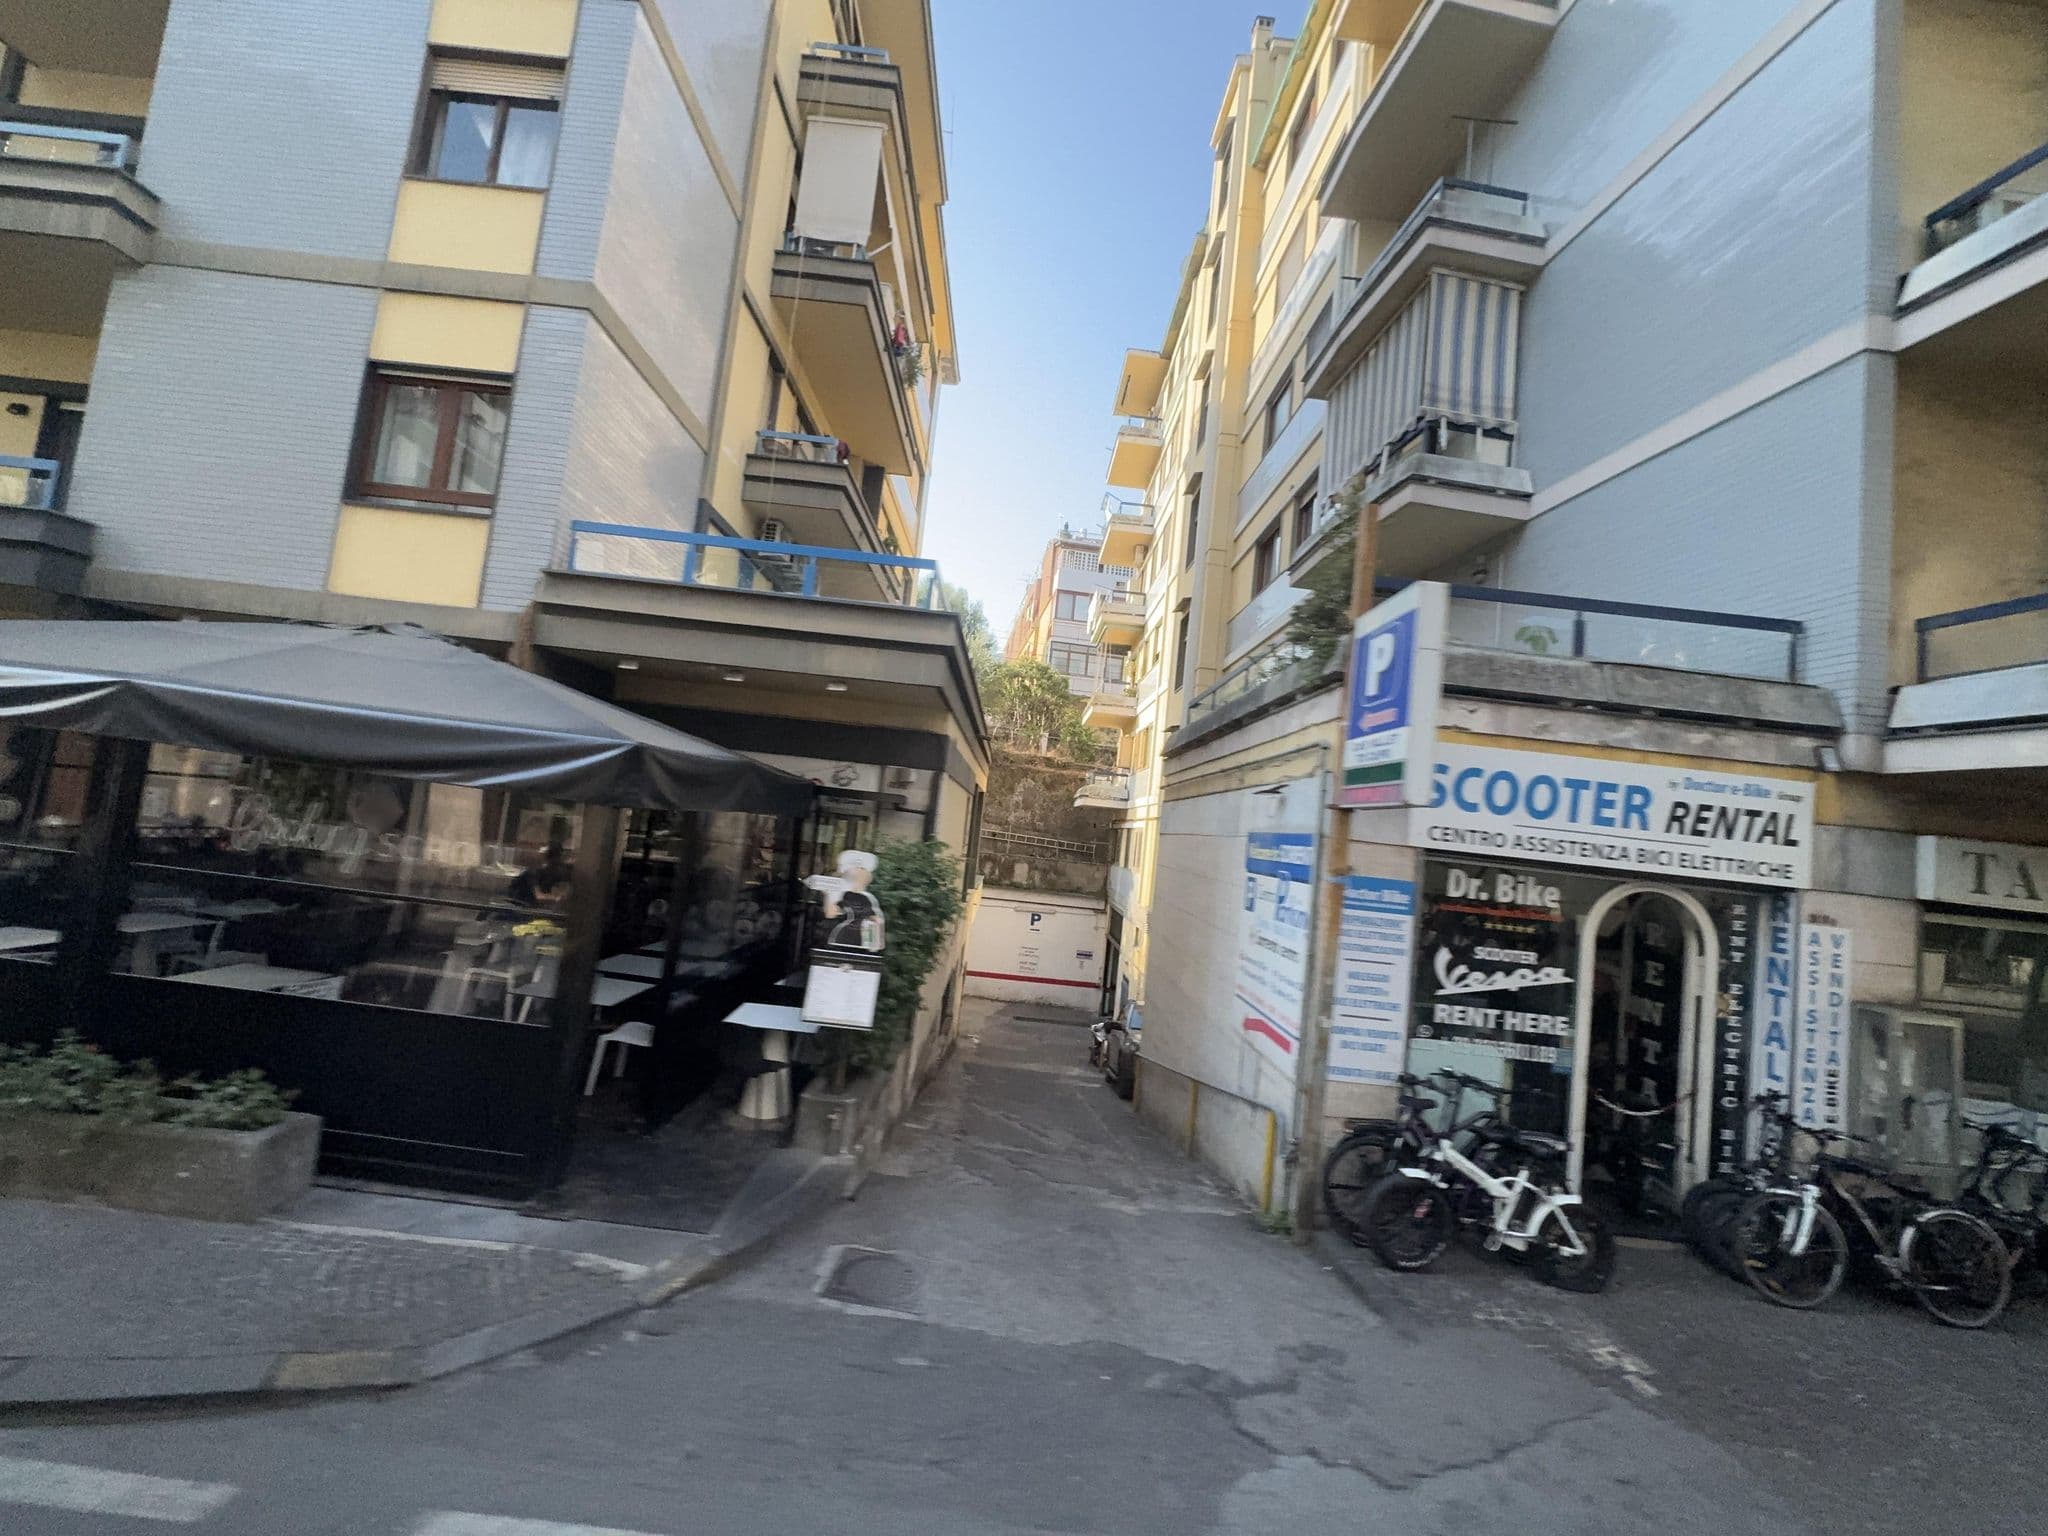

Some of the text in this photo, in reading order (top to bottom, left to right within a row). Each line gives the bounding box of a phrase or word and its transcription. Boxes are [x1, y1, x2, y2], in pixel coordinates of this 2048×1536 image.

[1364, 633, 1395, 696] P
[1432, 764, 1654, 831] SCOOTER
[1664, 800, 1801, 848] RENTAL
[1427, 825, 1794, 881] CENTRO ASSISTENZA BICI ELETTRICHE
[1446, 868, 1489, 901] Dr.
[1495, 873, 1562, 908] Bike
[1030, 912, 1042, 926] P
[1434, 945, 1575, 996] Vespa
[1763, 895, 1790, 1083] RENTAL
[1801, 931, 1823, 1124] ASSISTENZA
[1825, 933, 1845, 1067] VENDITA
[1718, 1128, 1737, 1174] BIK
